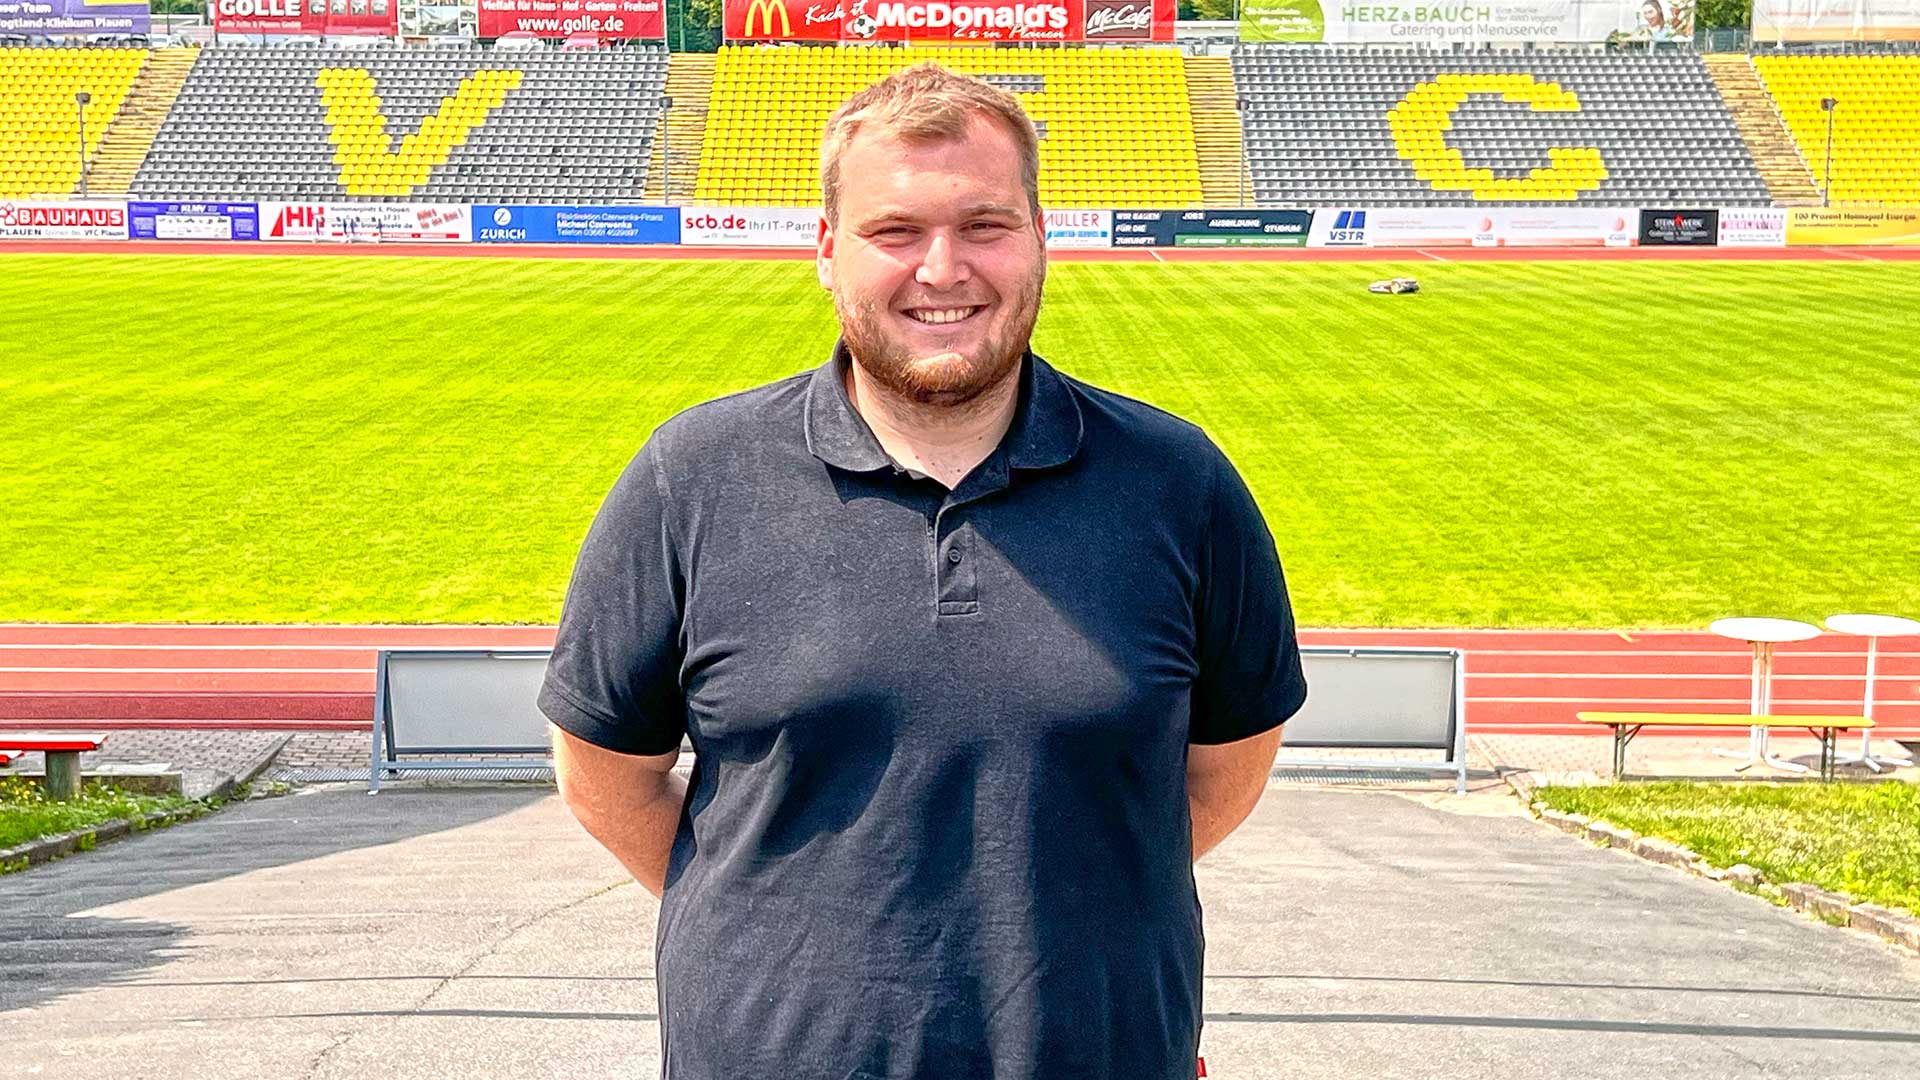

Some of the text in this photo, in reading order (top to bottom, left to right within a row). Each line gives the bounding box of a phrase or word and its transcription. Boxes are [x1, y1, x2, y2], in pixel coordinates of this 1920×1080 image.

[21, 2, 52, 13] Team
[219, 0, 301, 16] GOLLE
[481, 0, 658, 12] Vielfalt für Haus Hof Garten Freizeit
[805, 5, 846, 25] Kick
[876, 4, 1068, 28] McDonald's
[1342, 6, 1490, 22] HERZ & BAUCH
[0, 17, 133, 30] ogtland-Klinikum Plauen
[517, 15, 624, 34] www.golle.de
[1391, 23, 1442, 37] Catering
[1447, 24, 1472, 36] und
[1008, 24, 1065, 39] Plauen
[18, 208, 123, 226] BAUHAUS
[686, 214, 746, 230] scb.de
[749, 220, 764, 230] Ihr
[1115, 212, 1131, 220] WIR
[1182, 212, 1205, 220] JOBS
[1115, 222, 1147, 232] FÜR DIE
[1208, 219, 1261, 227] AUSBILDUNG
[1264, 224, 1302, 233] STUDIUM
[480, 229, 526, 239] ZURICH
[1329, 231, 1364, 241] VSTR
